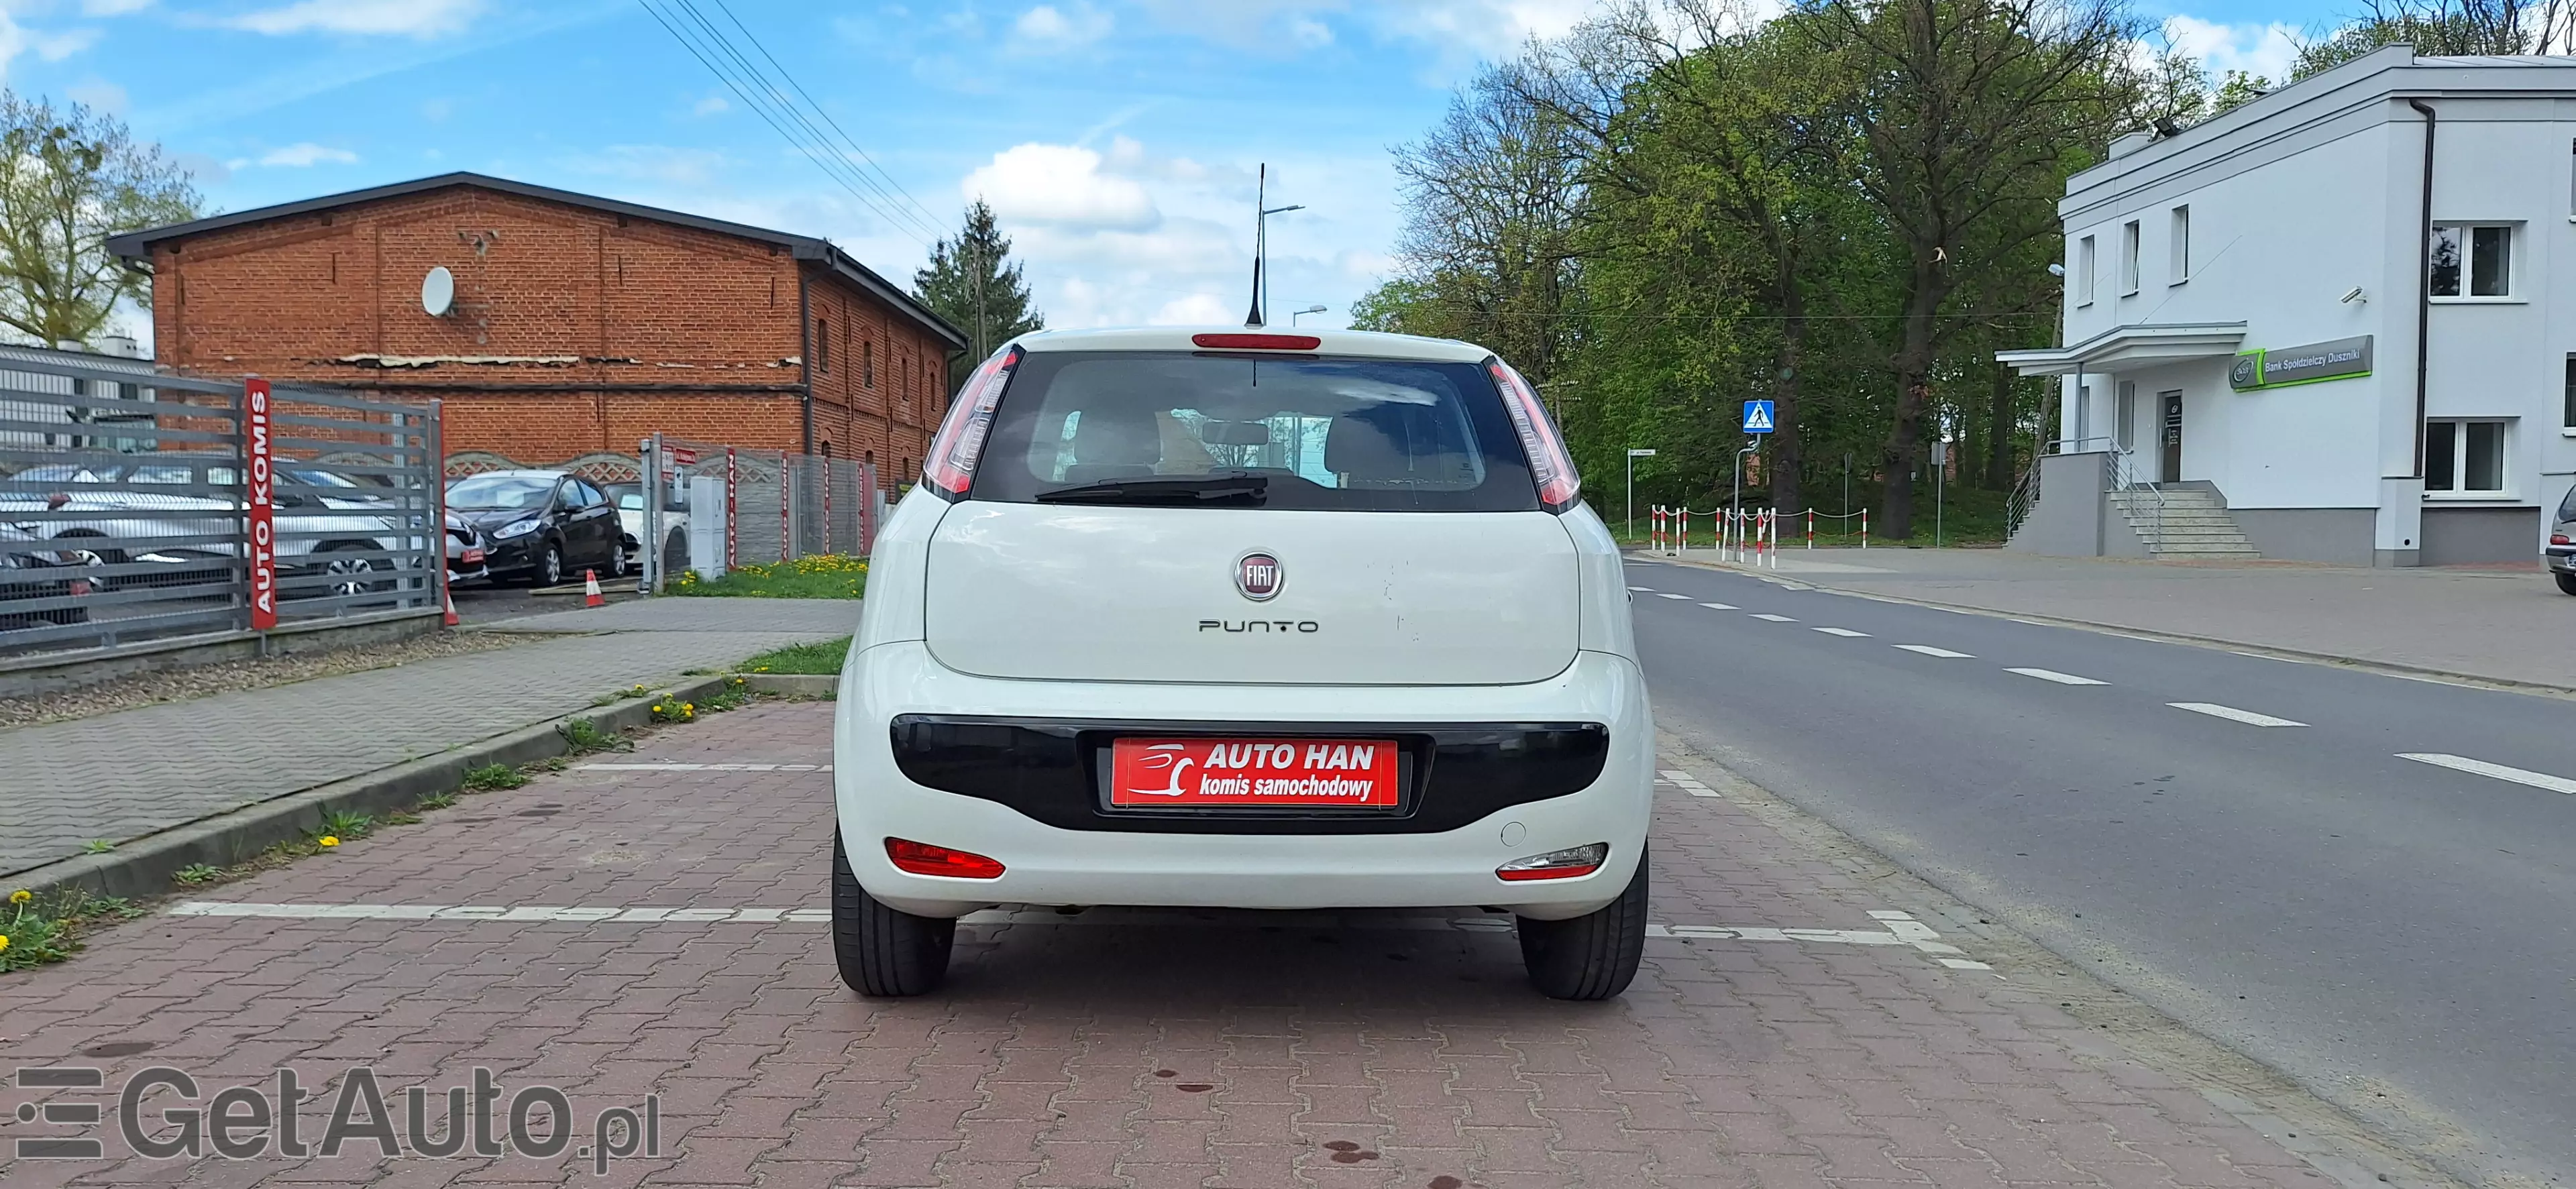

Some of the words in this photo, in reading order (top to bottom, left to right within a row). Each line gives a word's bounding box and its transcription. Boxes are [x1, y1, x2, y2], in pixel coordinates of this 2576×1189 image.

[2265, 361, 2282, 372] Bank
[2328, 349, 2360, 363] Duszniki
[252, 391, 268, 505] KOMIS
[256, 520, 272, 614] AUTO
[1246, 565, 1274, 586] FIAT
[1199, 620, 1319, 633] PUNTO
[1203, 744, 1295, 769] AUTO
[1303, 745, 1374, 770] HAN
[1199, 773, 1250, 795] komis
[1253, 774, 1373, 801] samochodowy
